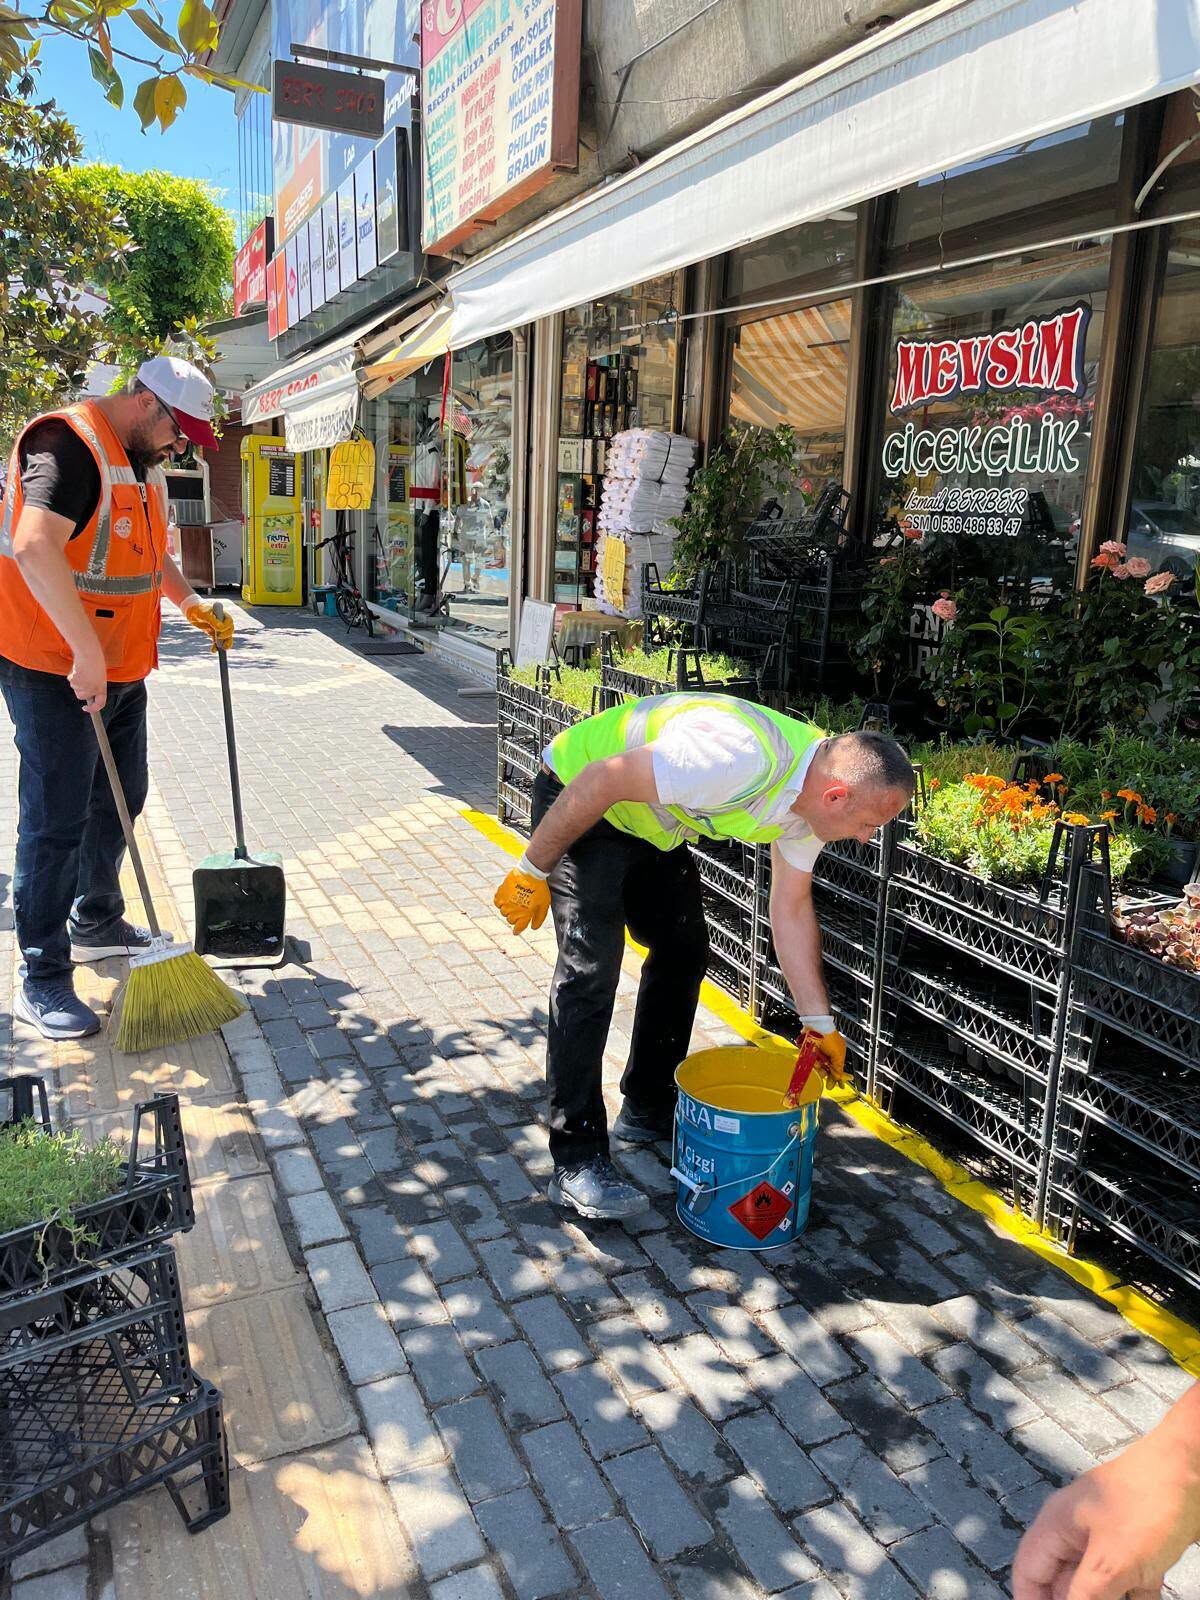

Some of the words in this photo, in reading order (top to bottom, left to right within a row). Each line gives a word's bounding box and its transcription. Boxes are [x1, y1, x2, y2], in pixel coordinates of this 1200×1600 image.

[457, 54, 484, 87] HÜLYA
[488, 21, 514, 57] EREN
[508, 117, 548, 160] PHILIPS
[507, 141, 546, 183] BRAUN
[336, 483, 362, 508] 85
[946, 488, 1028, 514] BERBER
[931, 514, 941, 532] 0
[941, 516, 962, 533] 536
[963, 517, 985, 535] 486
[987, 518, 1003, 536] 33
[1004, 518, 1022, 536] 47
[685, 1146, 715, 1174] Çizgi
